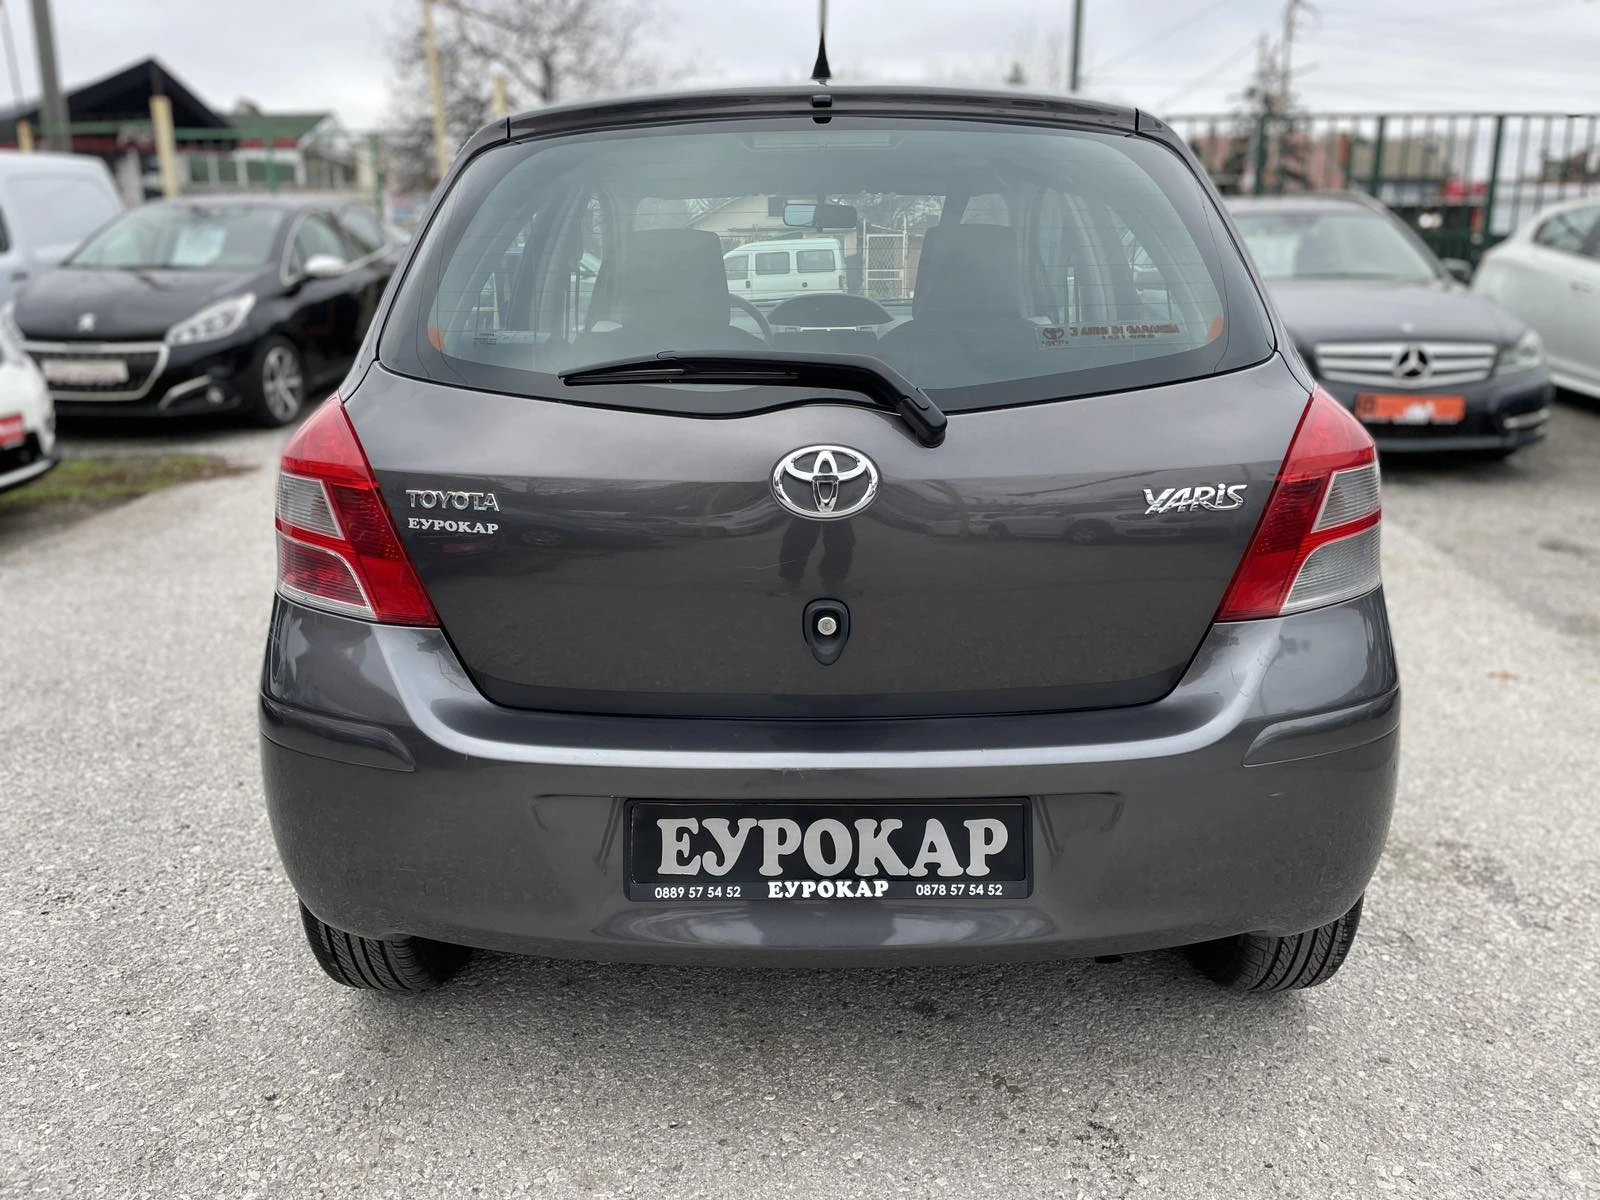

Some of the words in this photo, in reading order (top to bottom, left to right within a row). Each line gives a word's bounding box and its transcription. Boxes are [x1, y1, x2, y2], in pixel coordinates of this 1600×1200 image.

[1069, 326, 1078, 336] 3
[405, 489, 500, 512] TOYOTA
[407, 517, 499, 534] ЕУРОКАР
[656, 817, 1009, 878] ЕУРОКАР
[654, 886, 685, 899] 0889
[688, 886, 704, 899] 57
[707, 886, 722, 898] 54
[726, 886, 741, 898] 52
[767, 880, 889, 899] ЕУРОКАР
[915, 884, 947, 896] 0878
[949, 884, 965, 896] 57
[968, 884, 984, 896] 54
[987, 883, 1003, 896] 52
